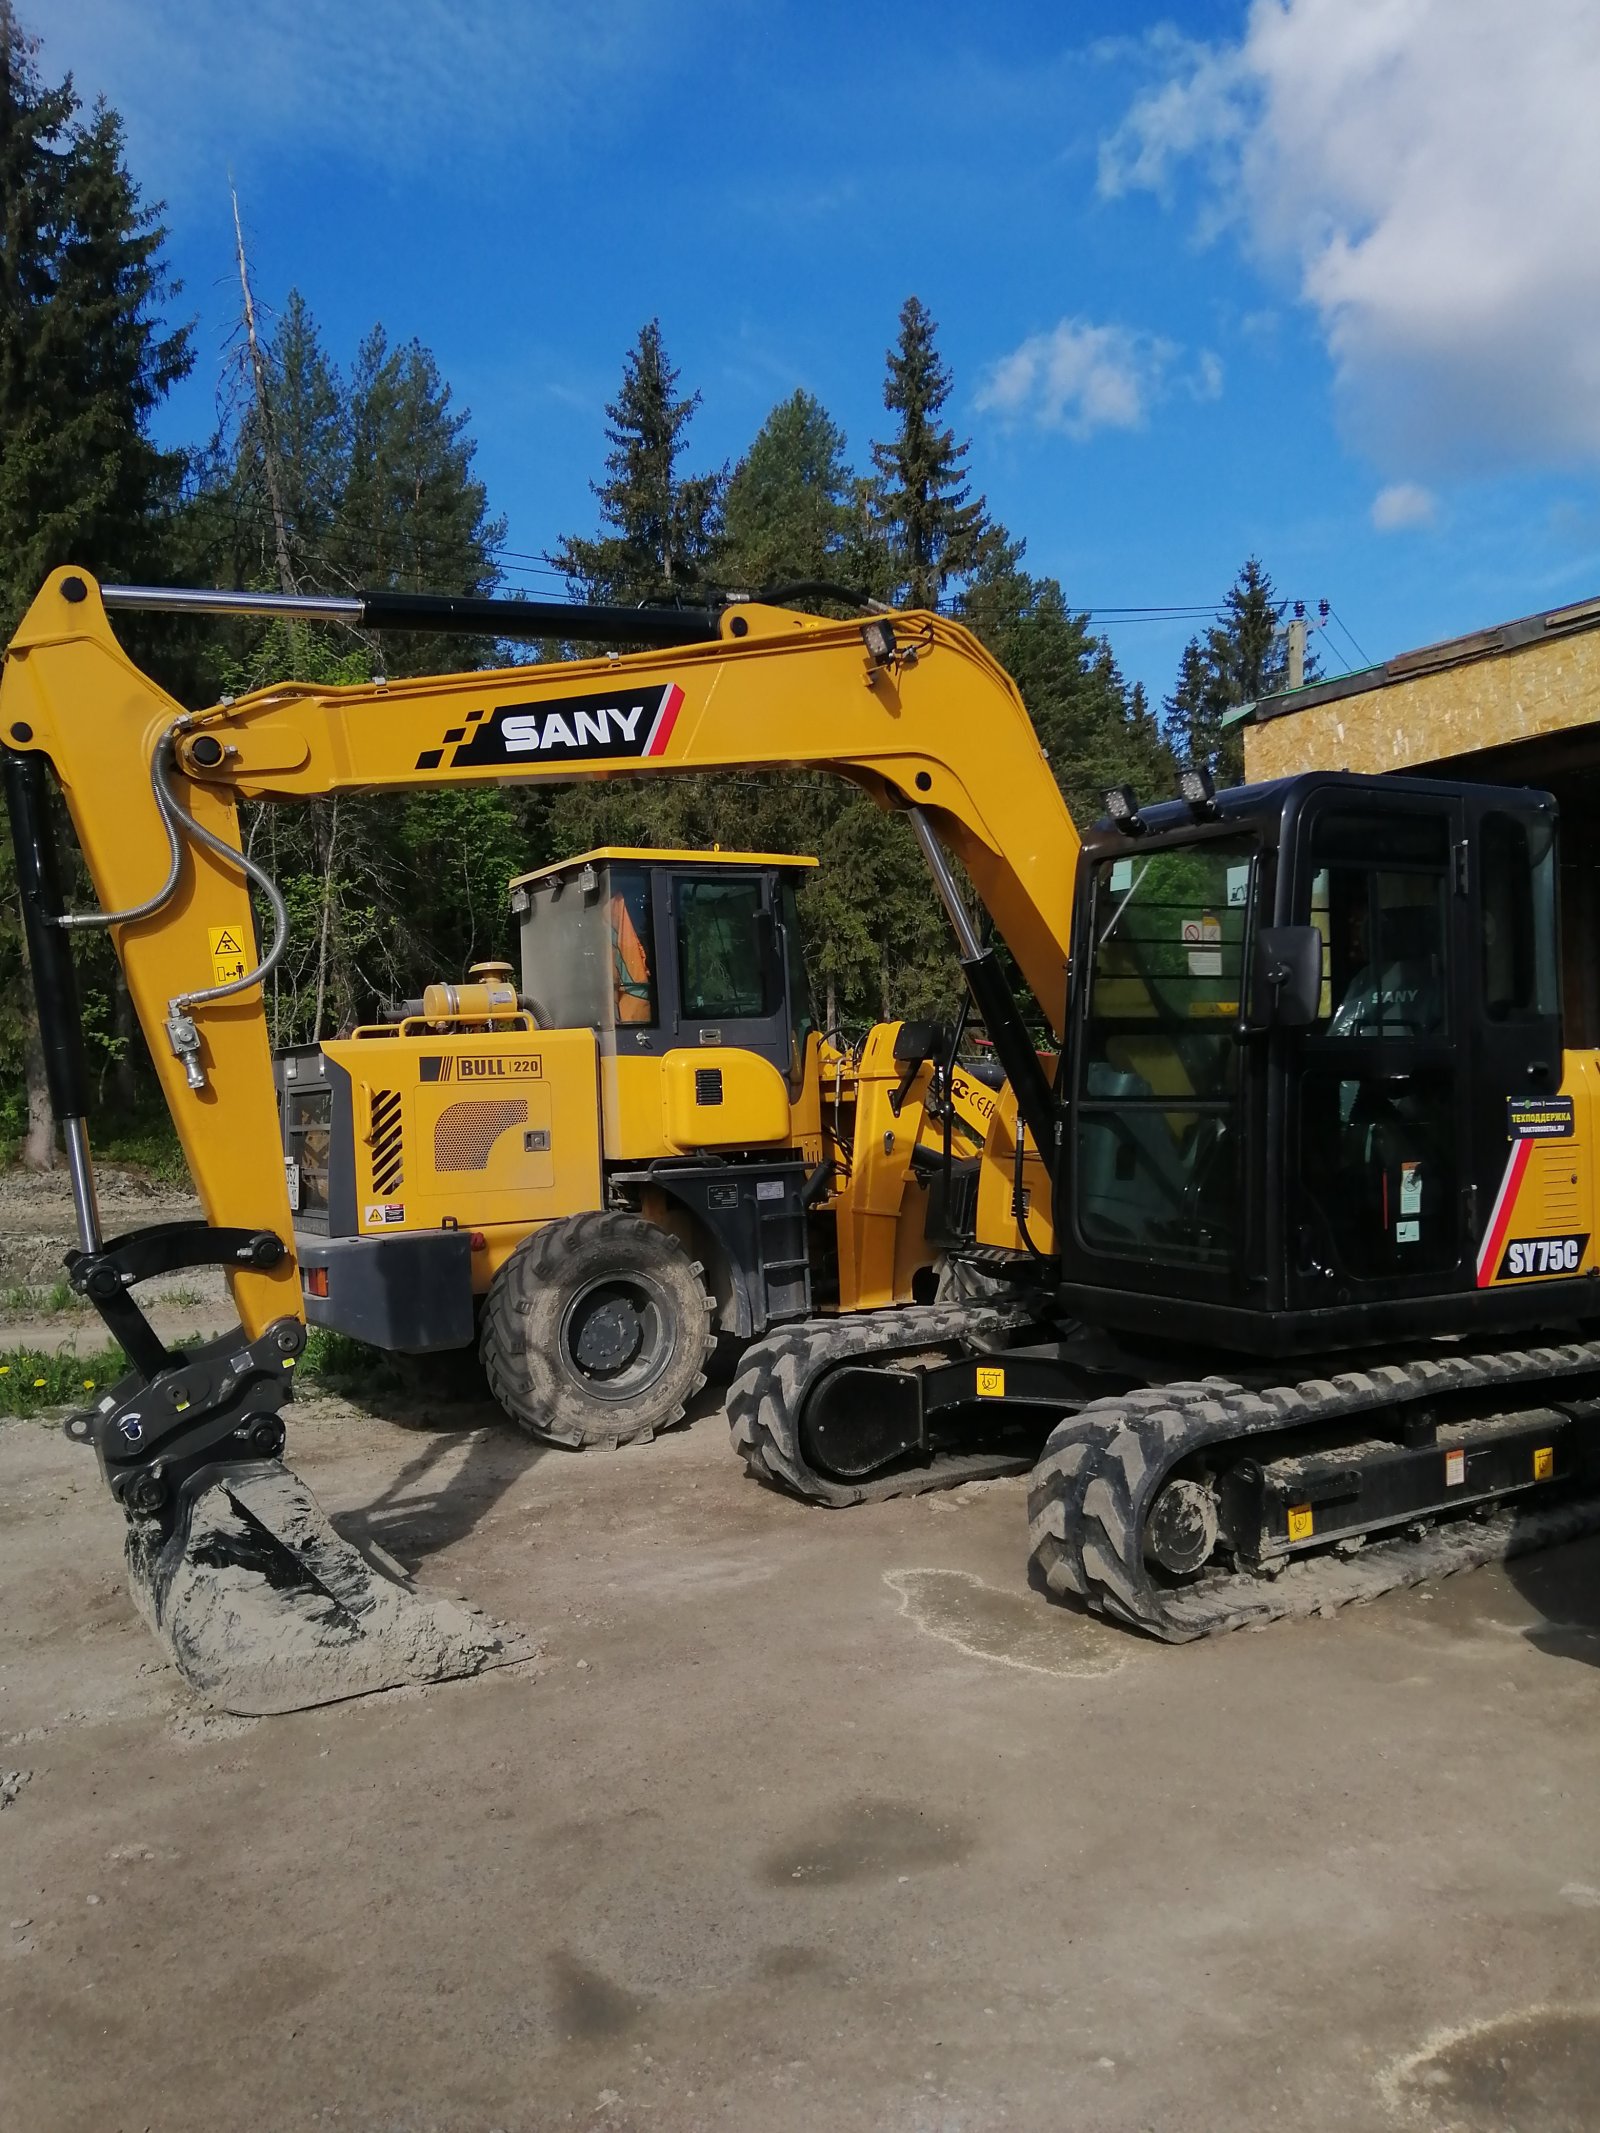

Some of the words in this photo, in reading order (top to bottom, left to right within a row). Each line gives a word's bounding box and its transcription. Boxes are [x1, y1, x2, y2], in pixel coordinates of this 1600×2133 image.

[501, 706, 643, 752] SANY
[461, 1059, 505, 1076] BULL
[513, 1060, 539, 1072] 220
[1511, 1112, 1572, 1124] ТЕХПОДДЕРЖКА
[1508, 1240, 1579, 1274] SY75C
